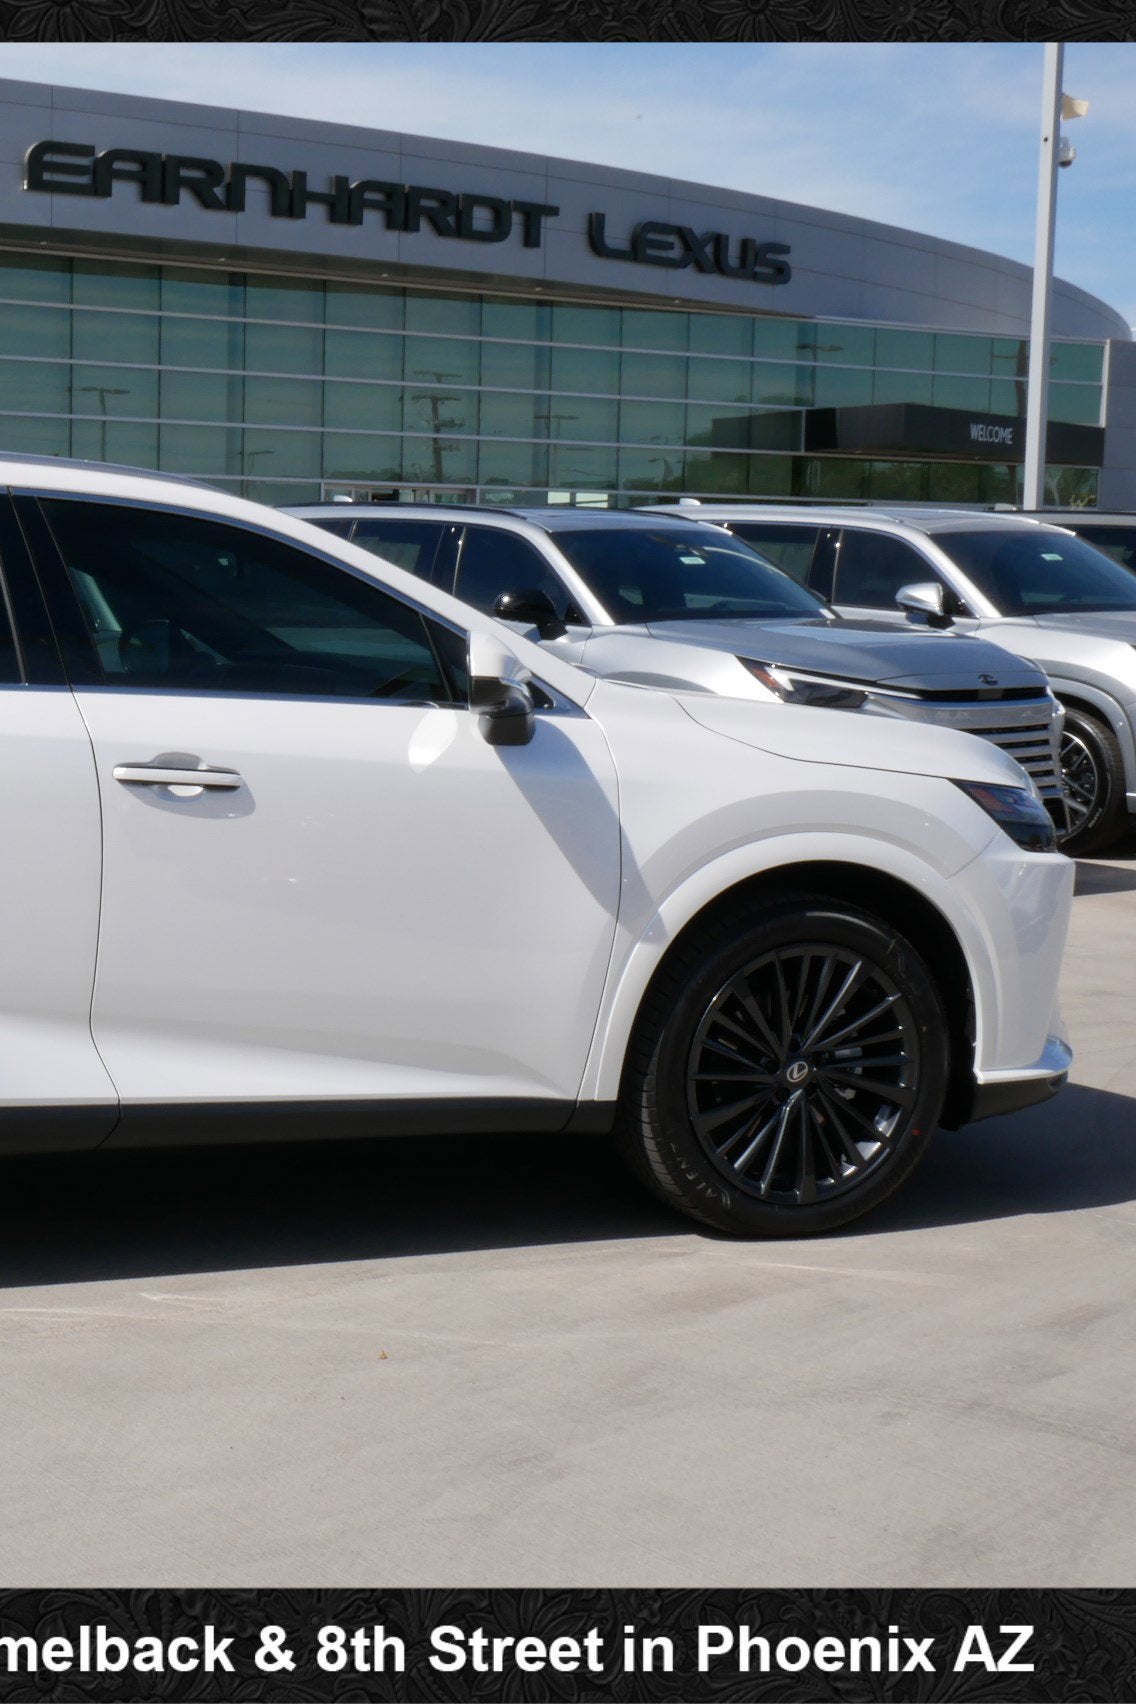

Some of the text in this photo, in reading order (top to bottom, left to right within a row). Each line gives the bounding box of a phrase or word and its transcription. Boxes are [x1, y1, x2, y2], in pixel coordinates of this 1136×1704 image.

[23, 140, 793, 285] EARNHARDT LEXUS
[970, 423, 1013, 444] WELCOME
